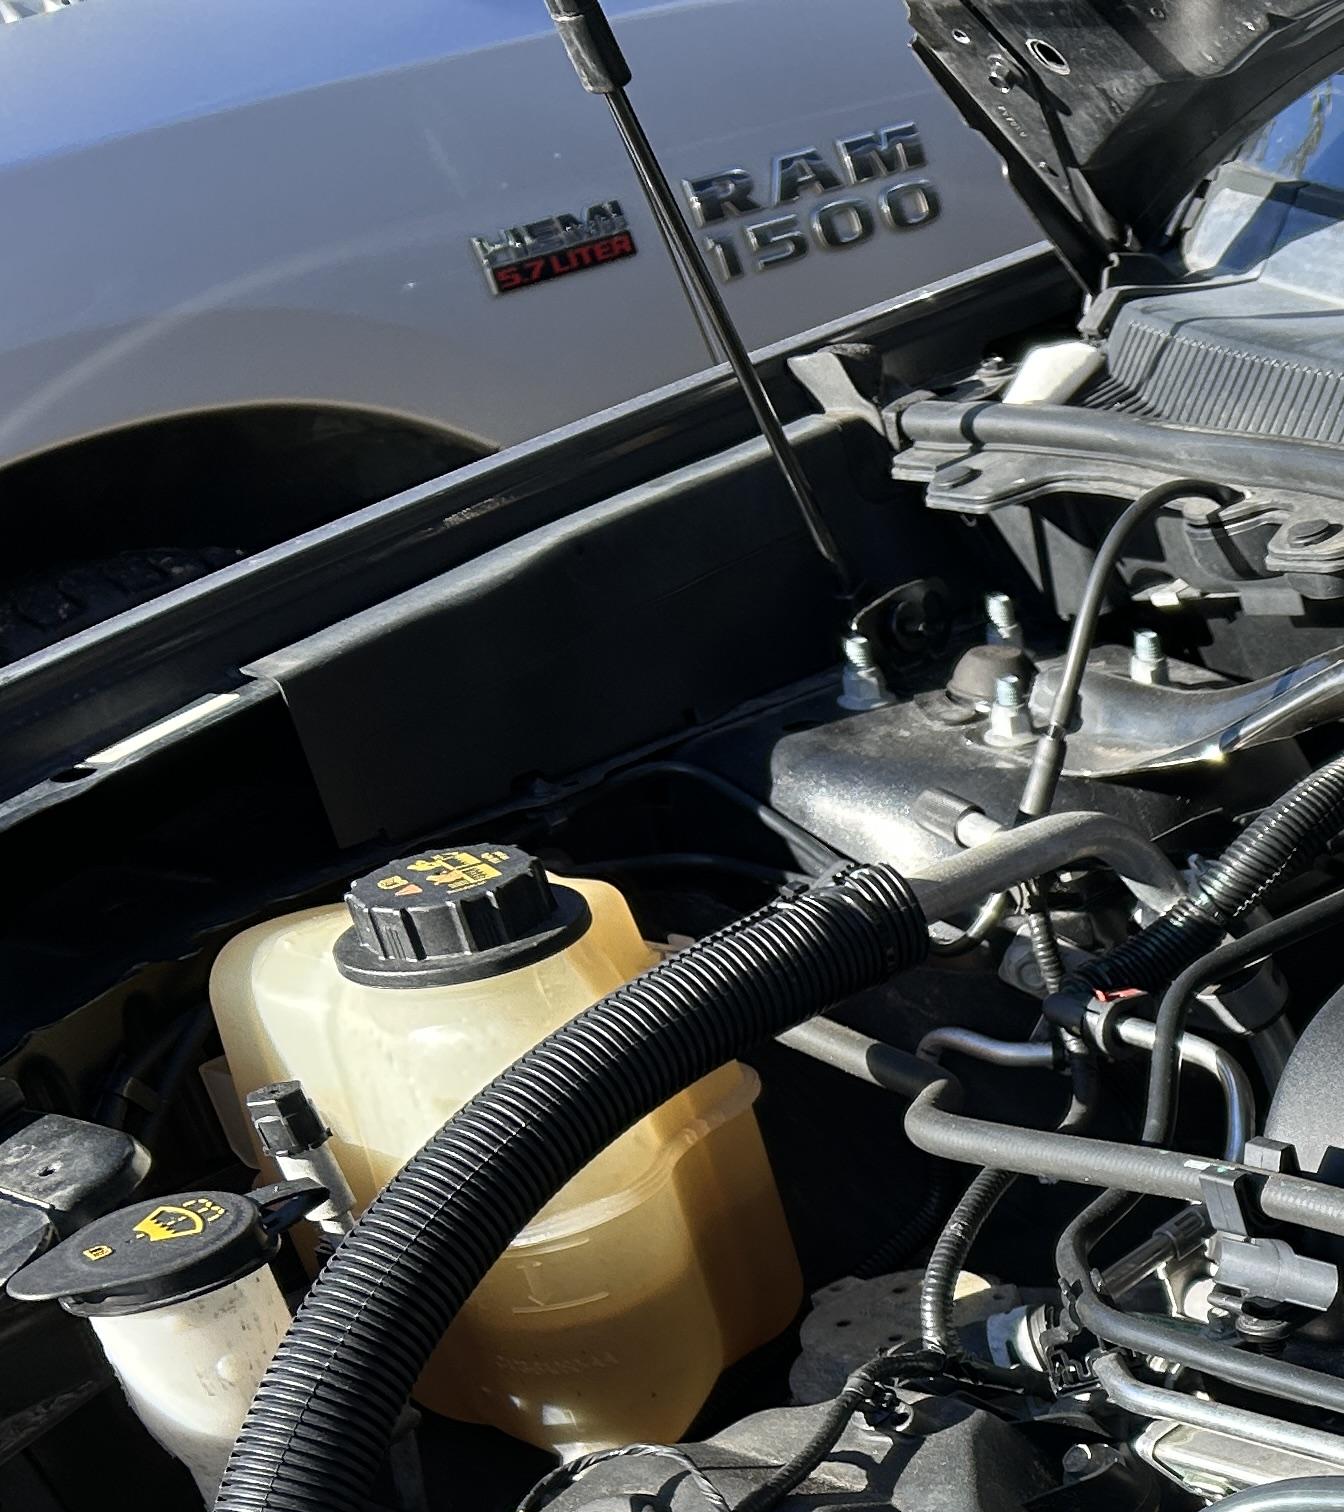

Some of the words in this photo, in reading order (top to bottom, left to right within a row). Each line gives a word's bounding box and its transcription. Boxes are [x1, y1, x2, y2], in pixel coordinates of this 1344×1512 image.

[681, 120, 927, 228] RAM
[470, 199, 629, 268] HEMI
[497, 258, 546, 293] 5.7
[551, 237, 635, 277] LITER
[704, 178, 942, 283] 1500
